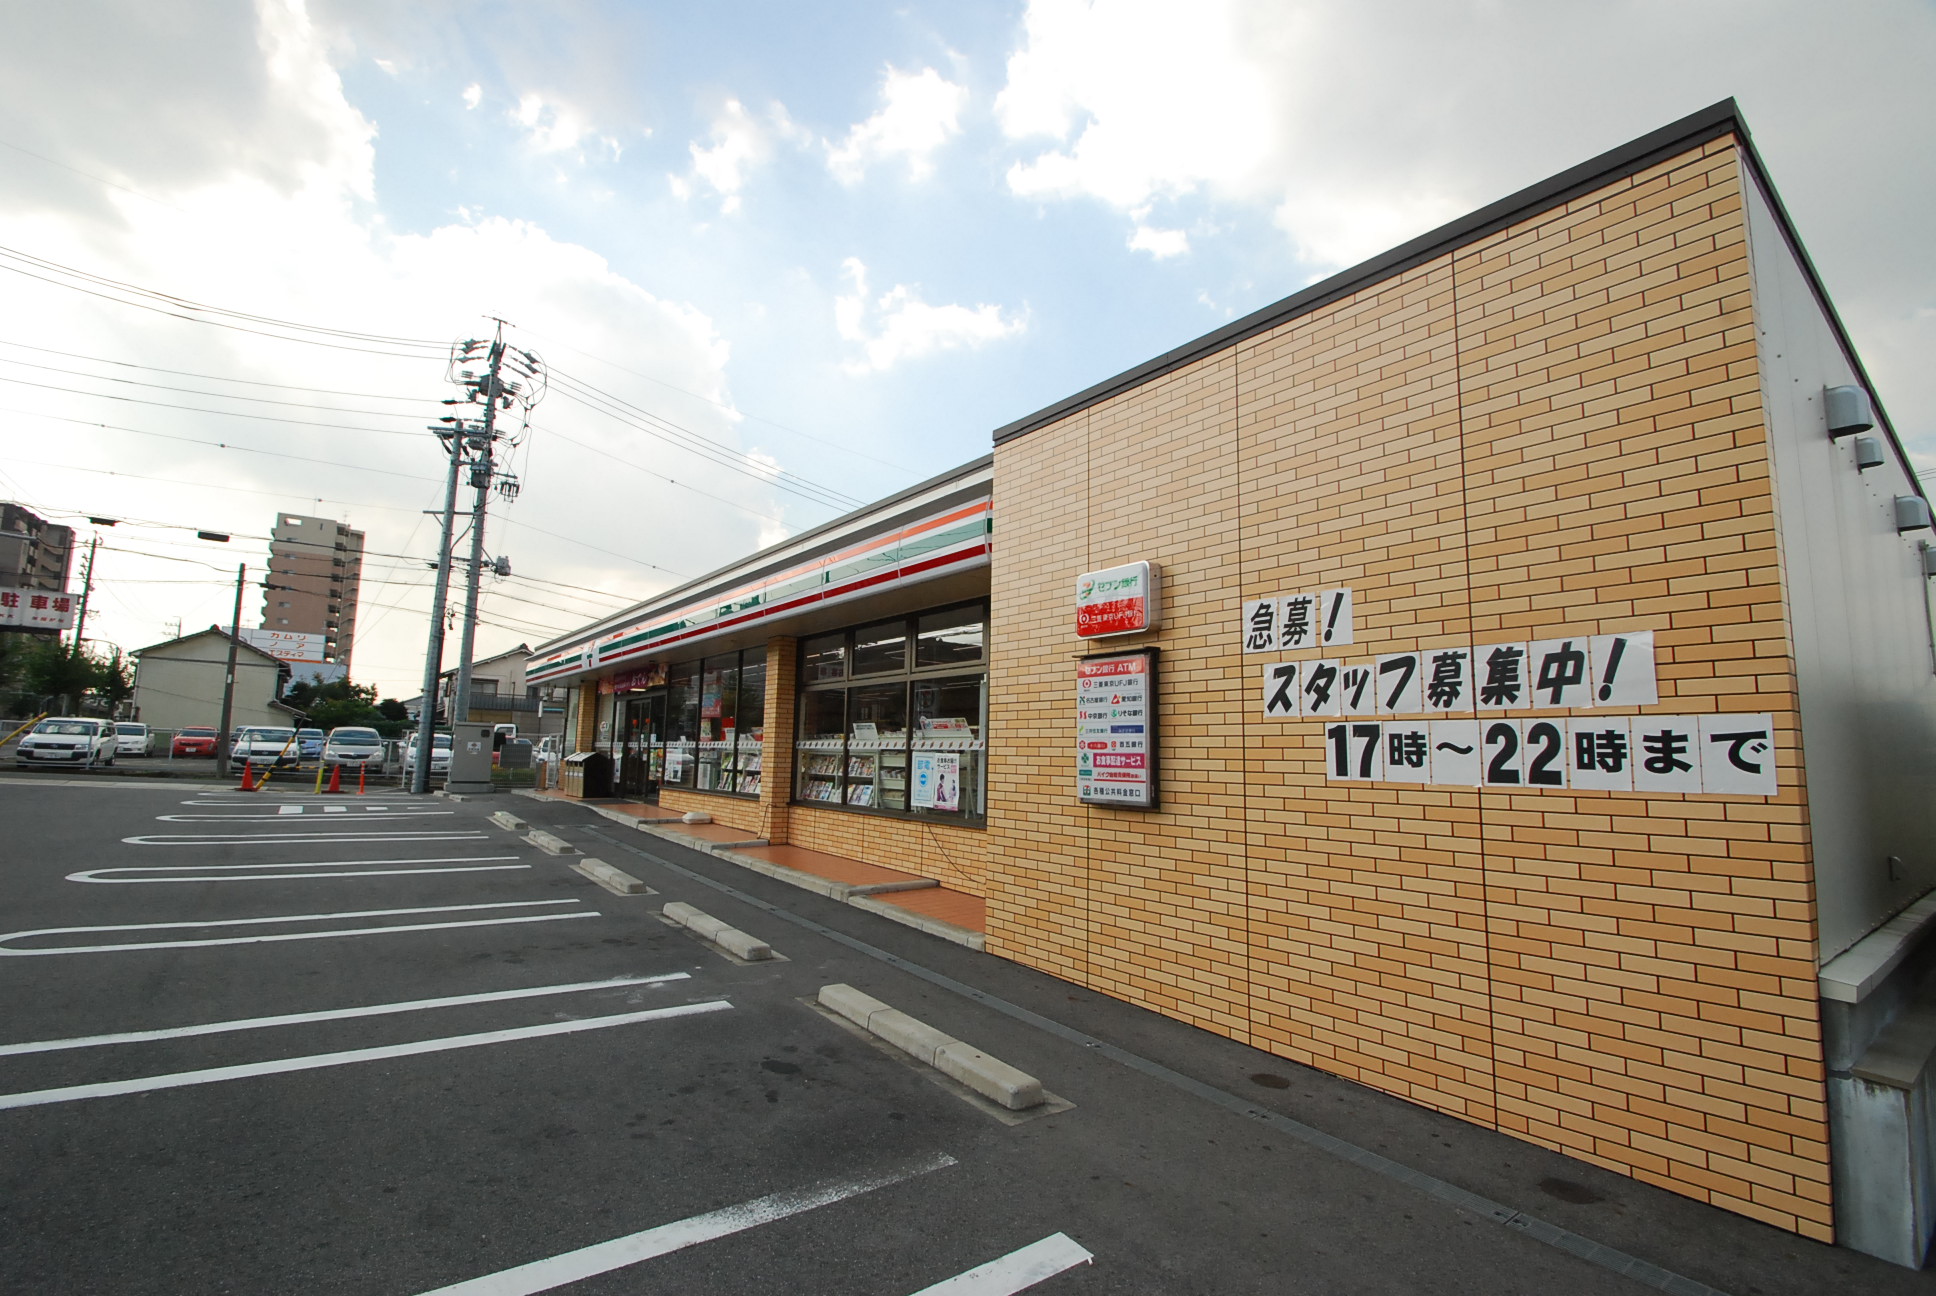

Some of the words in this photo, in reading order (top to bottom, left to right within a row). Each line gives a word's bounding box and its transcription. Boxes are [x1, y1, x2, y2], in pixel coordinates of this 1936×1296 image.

[1, 592, 71, 613] 駐車場
[1246, 592, 1344, 650] 急募!
[1117, 662, 1137, 673] ATM
[1266, 637, 1627, 714] スタッフ募集中!
